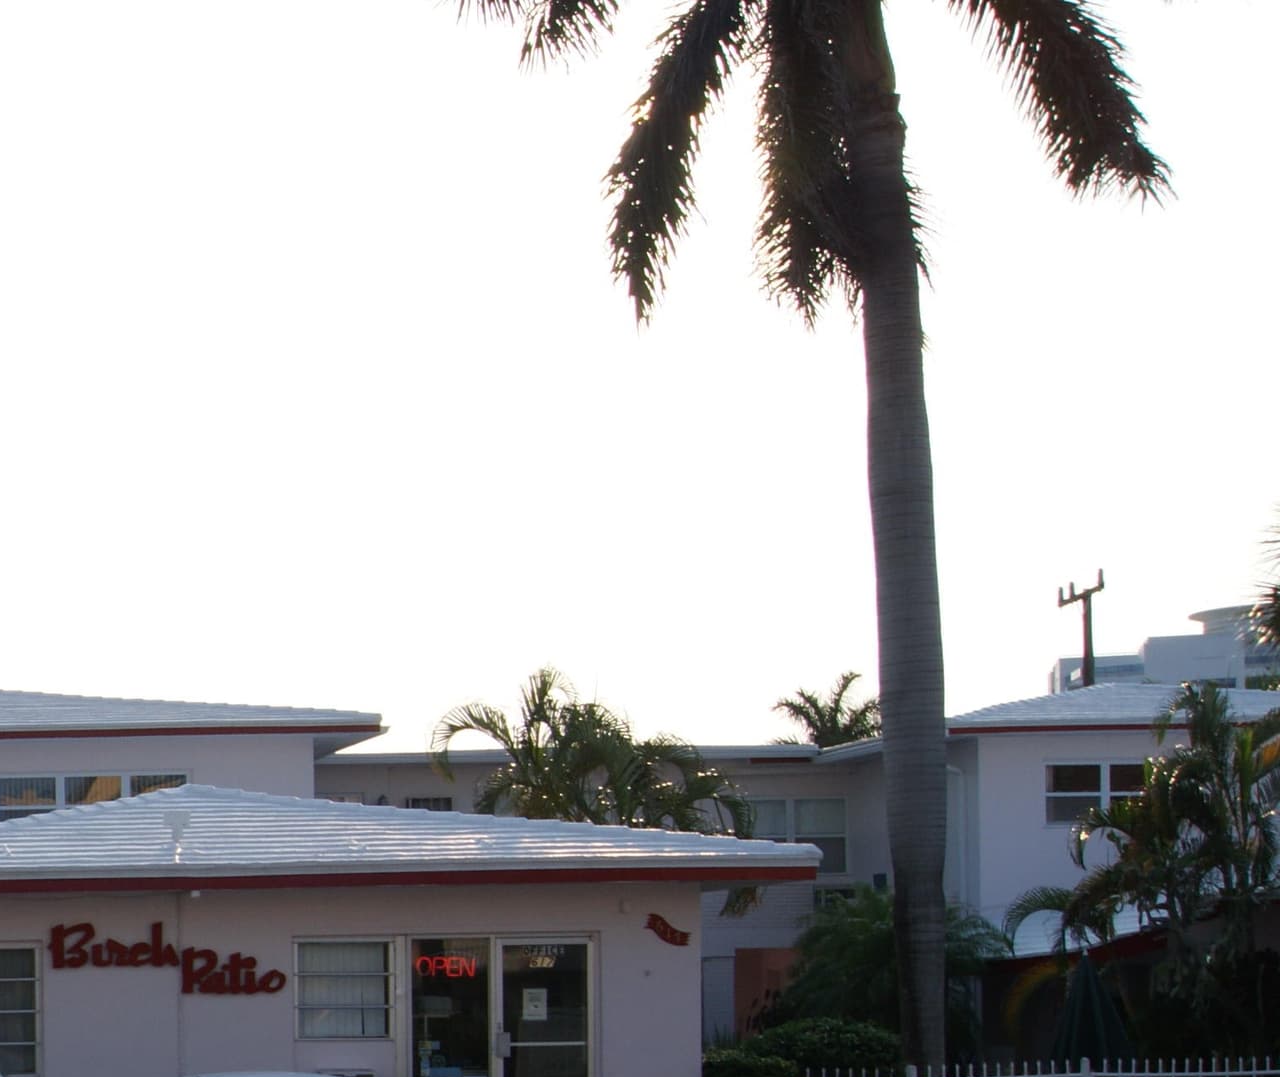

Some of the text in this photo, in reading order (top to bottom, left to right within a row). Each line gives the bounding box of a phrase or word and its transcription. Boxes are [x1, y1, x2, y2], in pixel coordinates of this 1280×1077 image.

[49, 921, 287, 994] Birch Patio
[415, 955, 477, 977] OPEN
